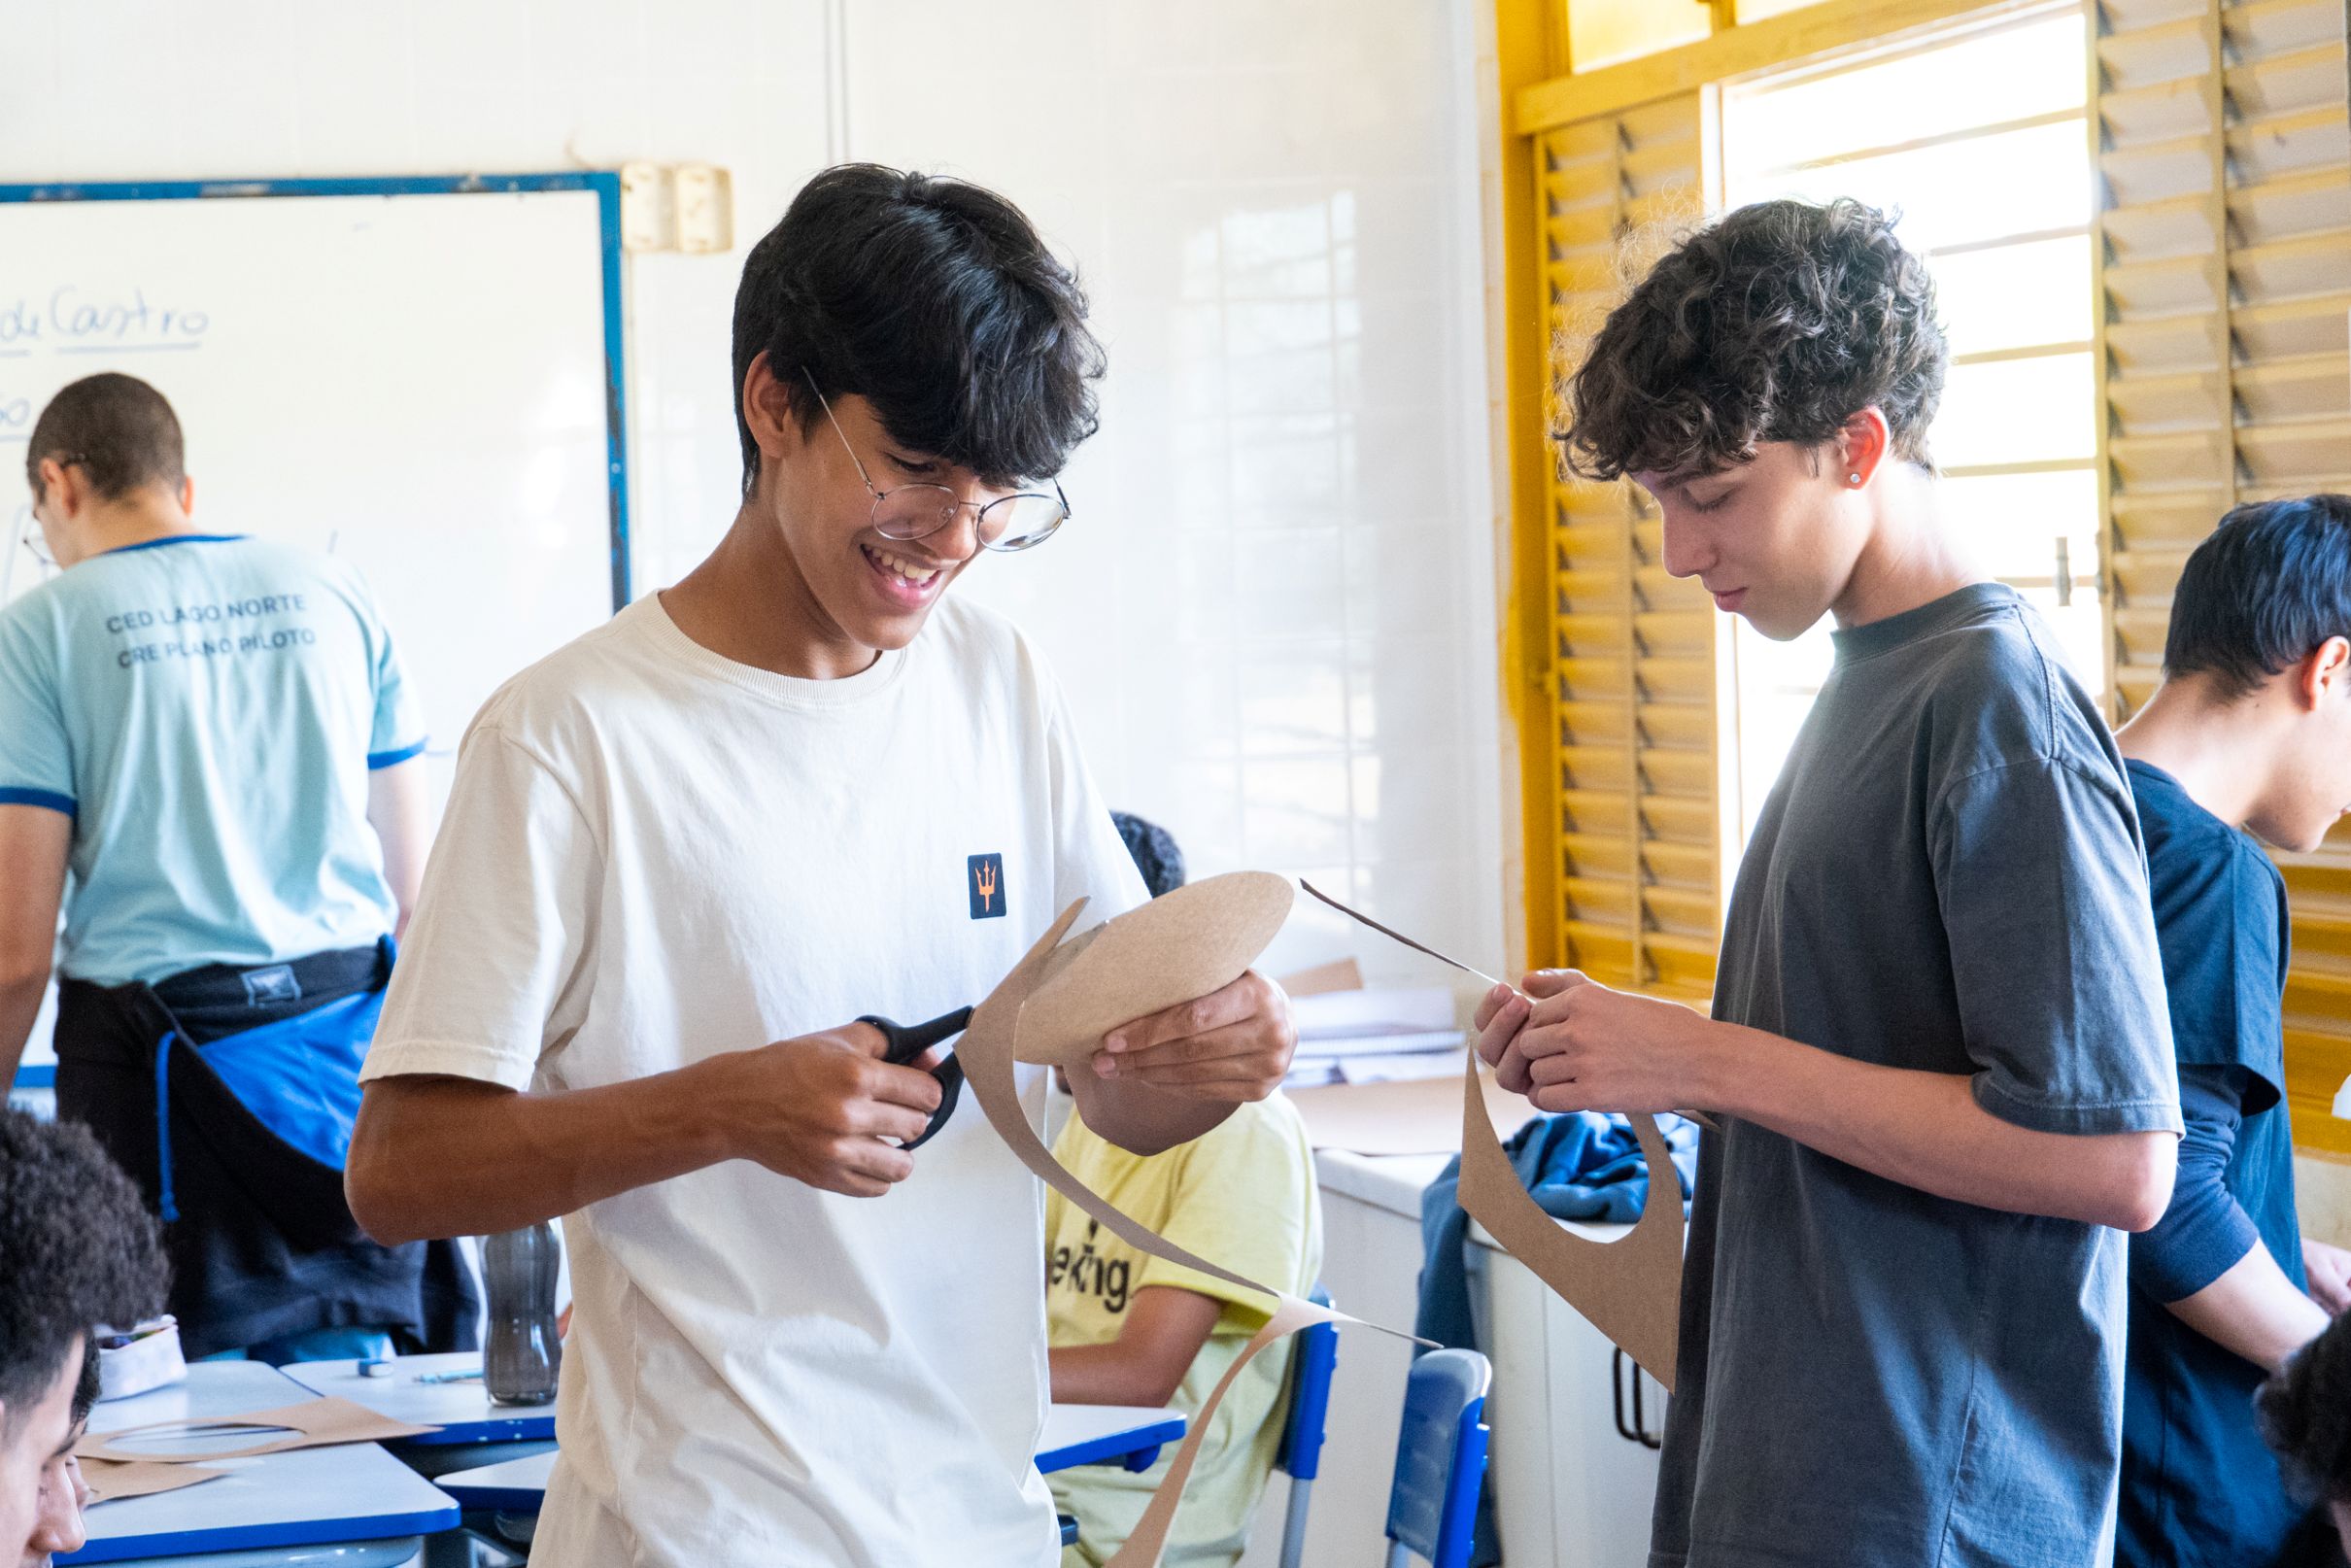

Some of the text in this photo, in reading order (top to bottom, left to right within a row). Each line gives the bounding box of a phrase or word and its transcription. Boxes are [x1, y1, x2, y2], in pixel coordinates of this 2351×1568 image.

[50, 285, 210, 339] Castro
[106, 594, 307, 634] CED LAGO NORTE
[117, 628, 316, 669] CRE PLANO PILOTO
